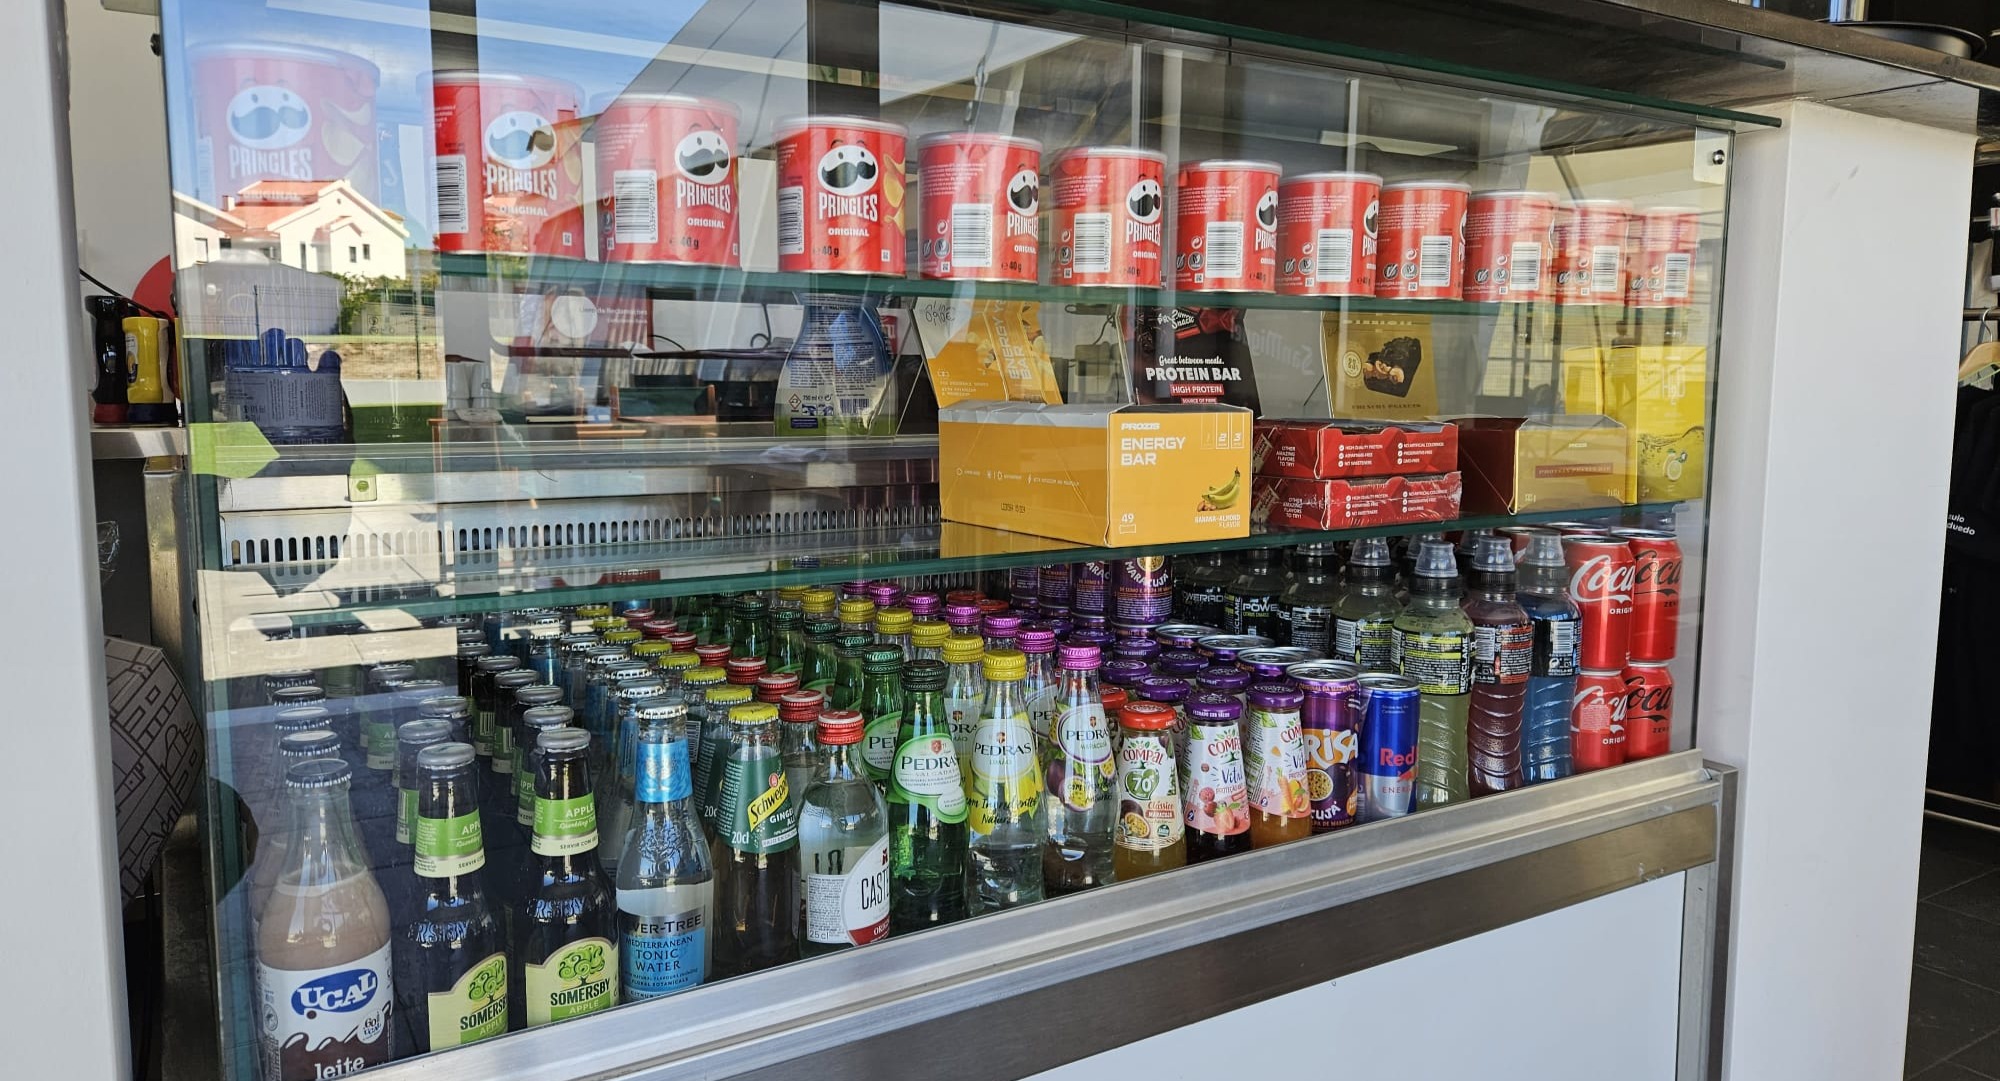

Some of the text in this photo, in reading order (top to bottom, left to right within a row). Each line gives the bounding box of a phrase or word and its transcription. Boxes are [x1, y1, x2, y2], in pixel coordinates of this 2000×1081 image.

[229, 144, 312, 181] PRINGLES
[486, 164, 558, 201] PRINGLES
[676, 178, 731, 214] PRINGLES
[499, 205, 550, 217] ORIGINAL
[819, 191, 878, 222] PRINGLES
[687, 217, 725, 229] ORIGINAL
[828, 226, 870, 237] ORIGINAL
[1012, 345, 1033, 380] BAR
[1158, 355, 1178, 366] Great
[1145, 367, 1242, 381] PROTEIN BAR
[1192, 385, 1222, 393] PROTEIN
[1121, 436, 1186, 450] ENERGY
[1120, 452, 1157, 465] BAR
[1121, 513, 1134, 523] 49
[1570, 554, 1636, 603] Coca
[975, 742, 1032, 756] PEDRAS
[1380, 746, 1415, 767] Red
[1132, 777, 1152, 792] 70
[731, 831, 749, 844] 20cl
[626, 934, 693, 949] MEDITERRANEAN
[635, 948, 679, 960] TONIC
[635, 960, 681, 972] WATER
[652, 977, 689, 987] BOTANICALS
[296, 972, 377, 1010] UCAL
[550, 978, 611, 1006] SOMERSBY
[568, 999, 599, 1015] APPLE
[314, 1056, 365, 1081] leite
